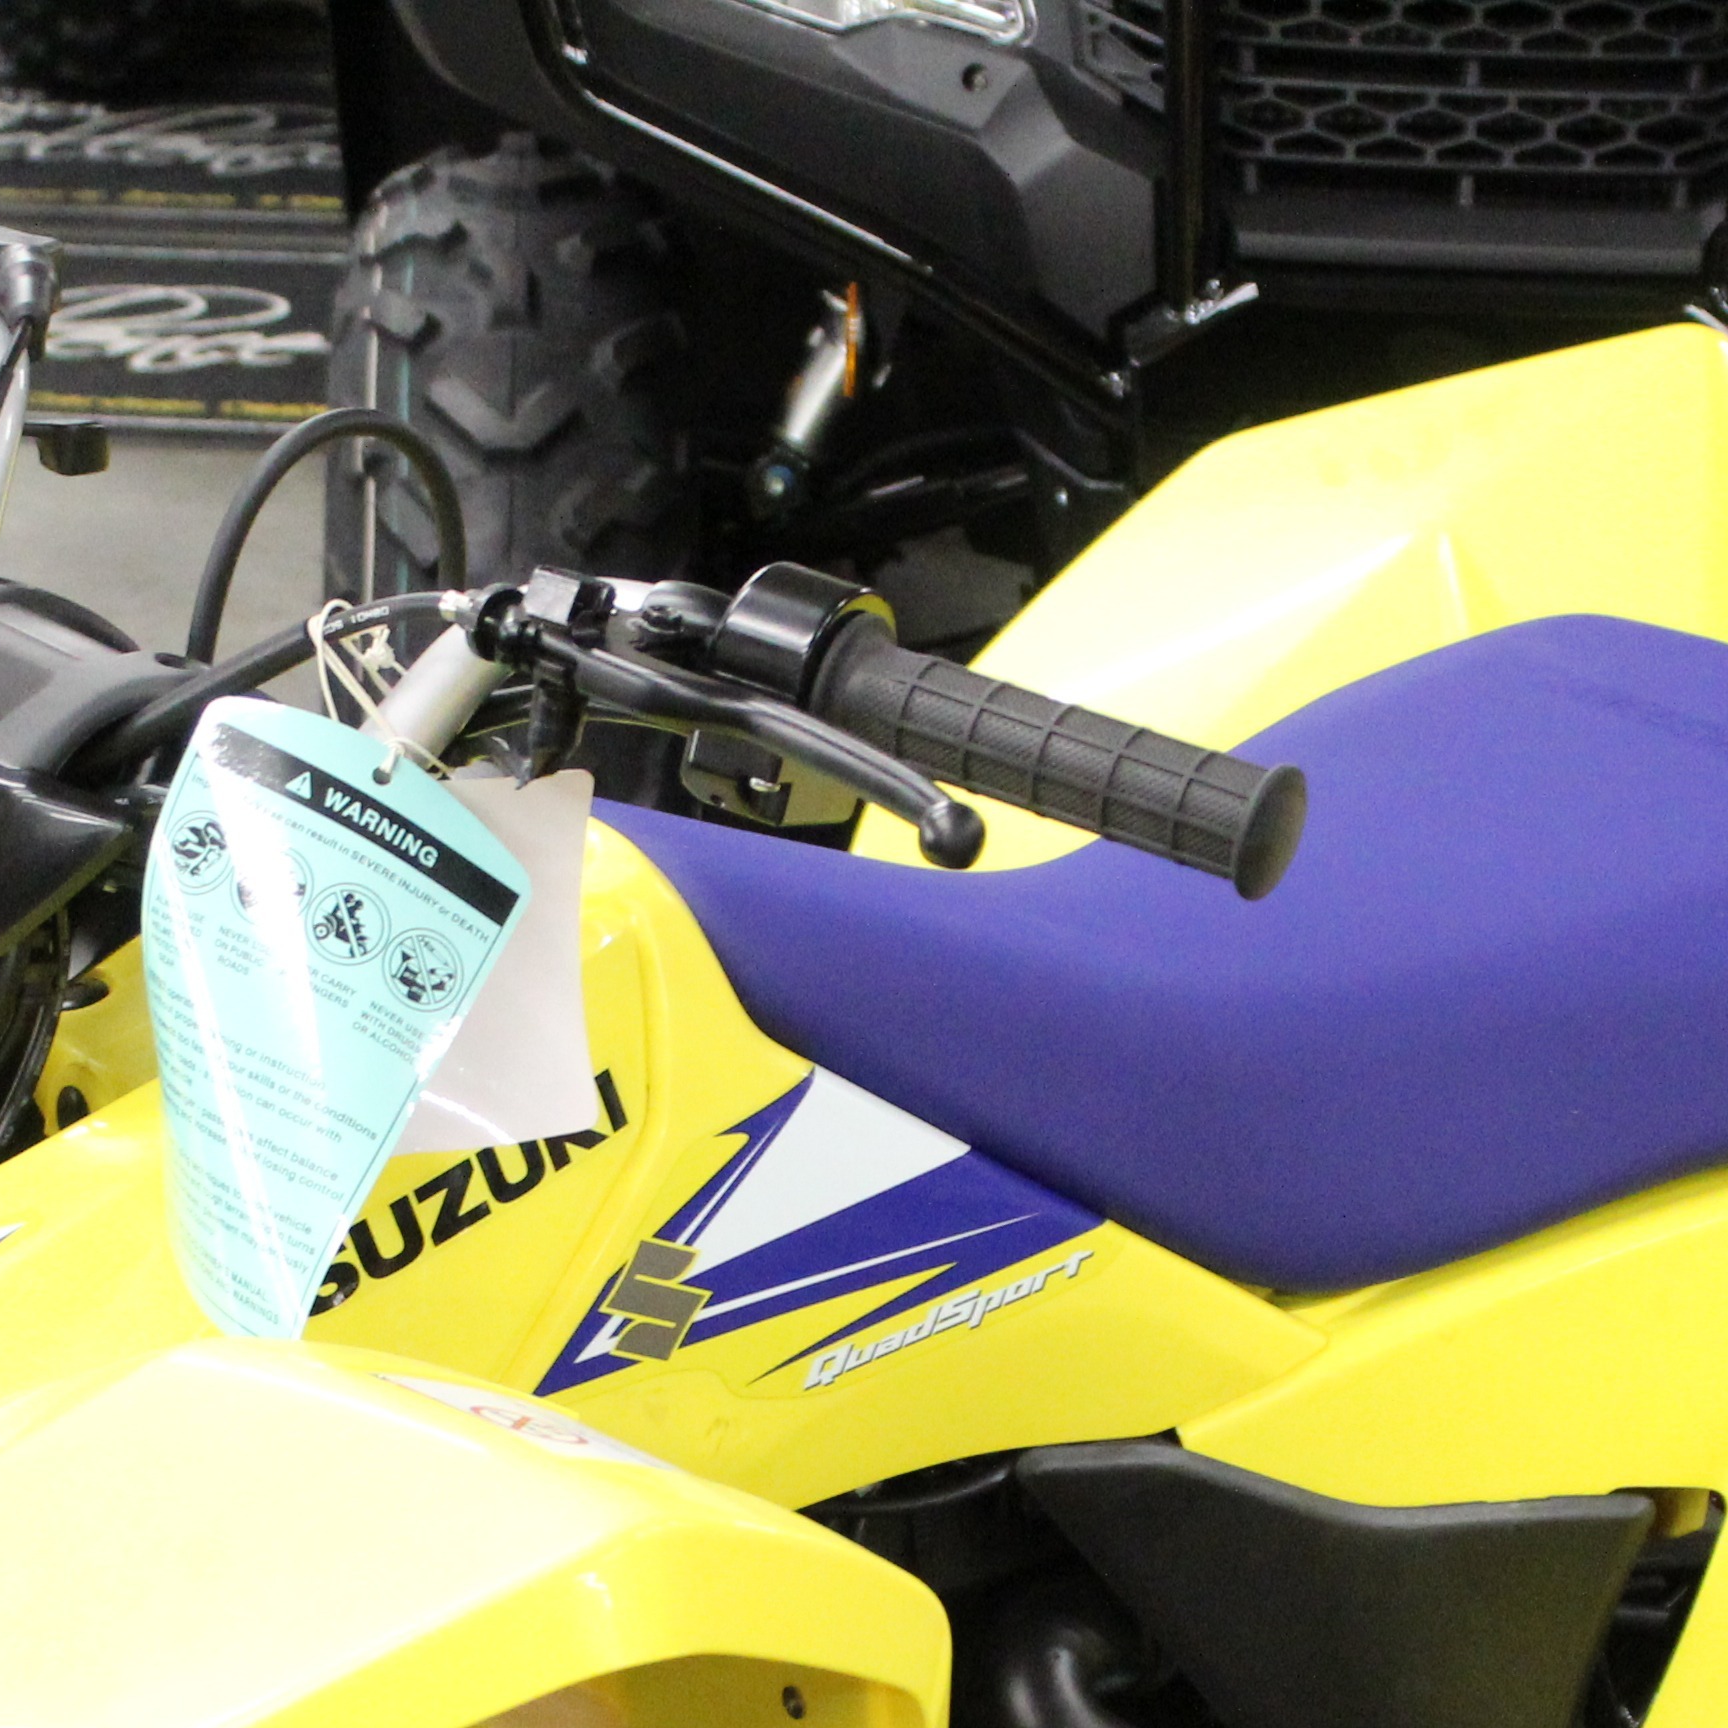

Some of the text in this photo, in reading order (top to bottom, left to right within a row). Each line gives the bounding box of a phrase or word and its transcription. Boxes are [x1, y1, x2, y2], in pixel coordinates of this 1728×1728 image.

[320, 786, 441, 869] WARNING
[285, 817, 305, 832] can
[304, 825, 338, 850] result
[337, 843, 350, 857] in
[349, 849, 398, 883] SEVERE
[395, 877, 439, 910] INJURY
[438, 905, 450, 917] or
[449, 912, 490, 944] DEATH
[218, 924, 250, 946] NEVER
[213, 937, 230, 951] ON
[229, 943, 266, 967] PUBLIC
[216, 953, 250, 977] ROADS
[319, 972, 357, 998] CARRY
[351, 1019, 369, 1037] OR
[359, 1008, 388, 1031] WITH
[368, 999, 404, 1028] NEVER
[244, 1046, 258, 1058] or
[257, 1051, 328, 1092] instruction
[246, 1067, 278, 1090] skills
[276, 1083, 291, 1096] or
[291, 1089, 313, 1108] the
[311, 1099, 379, 1142] conditions
[254, 1095, 277, 1112] can
[278, 1106, 313, 1128] occur
[314, 1122, 343, 1145] with
[255, 1133, 339, 1184] affect balance
[260, 1154, 298, 1181] losing
[297, 1173, 344, 1204] control
[272, 1208, 313, 1235] vehicle
[285, 1234, 317, 1256] turns
[803, 1249, 1095, 1391] QuadSport
